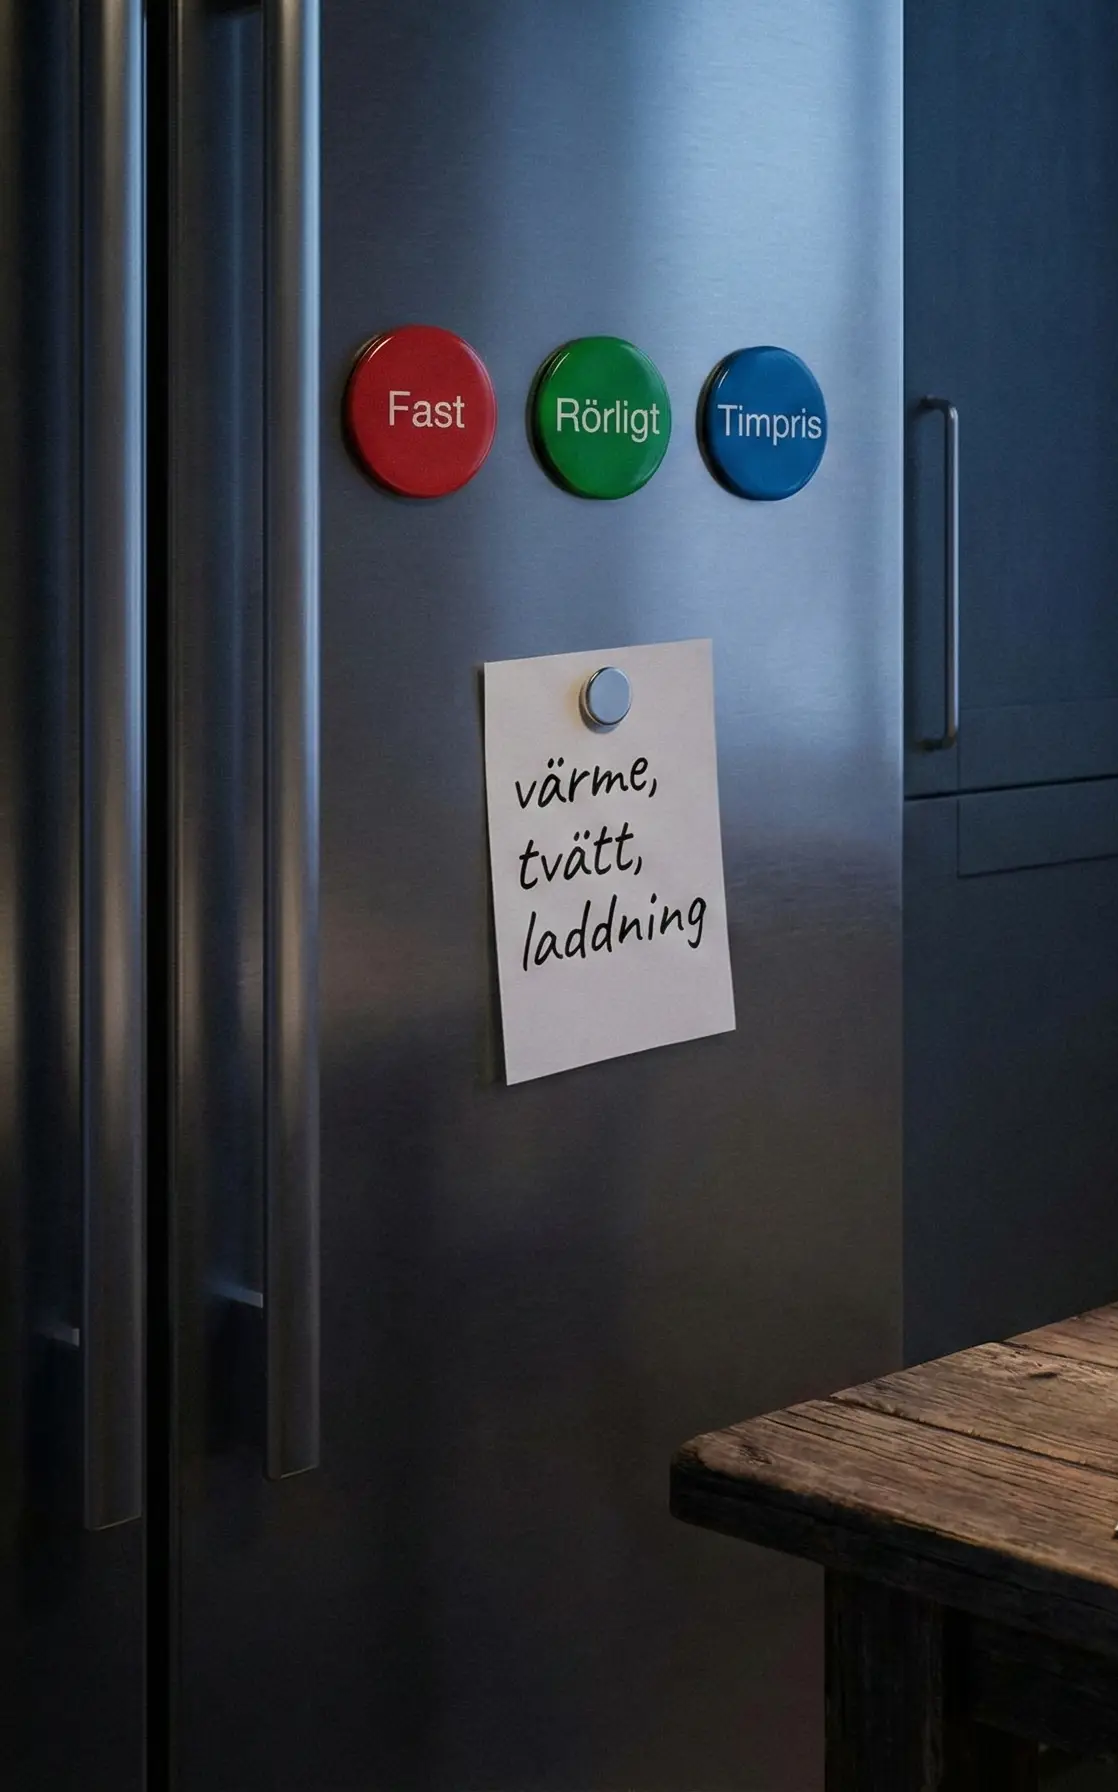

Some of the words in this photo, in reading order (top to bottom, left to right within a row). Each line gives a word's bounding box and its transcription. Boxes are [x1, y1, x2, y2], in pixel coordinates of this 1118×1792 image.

[388, 390, 465, 429] Fast
[556, 397, 660, 443] Rörligt
[718, 404, 822, 445] Timpris
[515, 757, 657, 809] värme,
[519, 822, 642, 890] tvätt,
[523, 893, 707, 971] laddning
